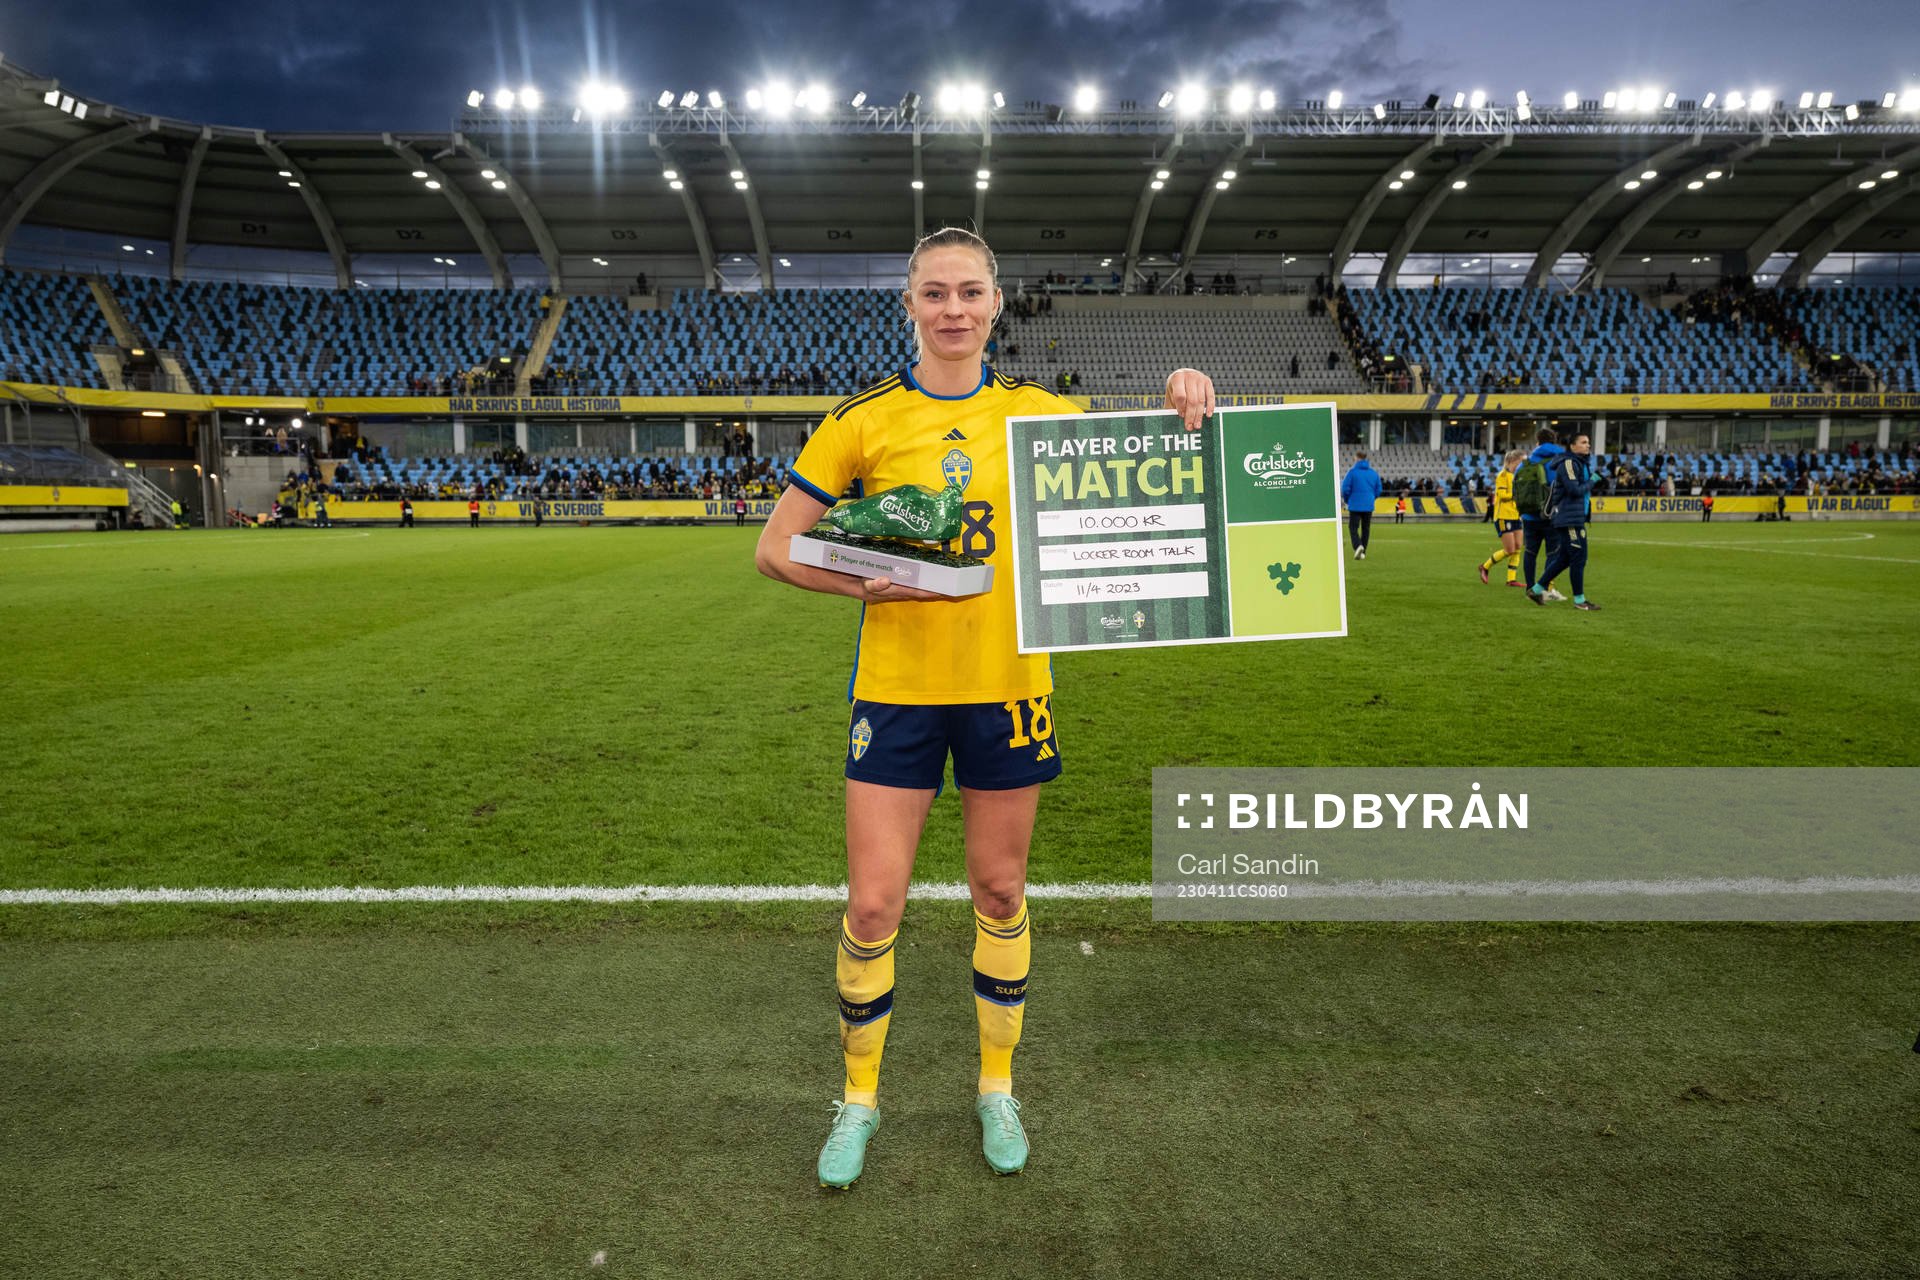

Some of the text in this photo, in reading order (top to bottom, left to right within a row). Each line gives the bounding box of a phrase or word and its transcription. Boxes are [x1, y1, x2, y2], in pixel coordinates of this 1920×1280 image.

[241, 222, 268, 234] D1
[396, 228, 425, 240] D2
[1464, 229, 1490, 240] F4
[610, 230, 638, 240] D3
[826, 230, 853, 240] D4
[1040, 230, 1066, 240] D5
[1254, 230, 1280, 240] F5
[476, 399, 519, 410] SKRIVS
[567, 398, 621, 410] HISTORIA
[1796, 396, 1837, 408] SKRIVS
[1033, 433, 1202, 458] PLAYER OF THE
[1243, 452, 1315, 479] Carlsberg
[1034, 456, 1204, 501] MATCH
[519, 503, 531, 516] VI
[554, 503, 605, 516] SVERIGE
[705, 502, 718, 515] VI
[1626, 498, 1638, 512] VI
[1660, 498, 1704, 512] SVERIG
[1807, 498, 1819, 510] VI
[880, 495, 931, 532] Carlsberg
[1079, 514, 1166, 529] 10.000 KR
[942, 501, 996, 558] 8
[1073, 549, 1120, 561] LOCKER
[1122, 548, 1154, 559] ROOM
[1159, 546, 1196, 557] TALK
[841, 555, 858, 565] Player
[865, 560, 874, 569] the
[875, 564, 893, 572] match
[1076, 582, 1141, 598] 11/4 2023
[1004, 694, 1053, 749] 18
